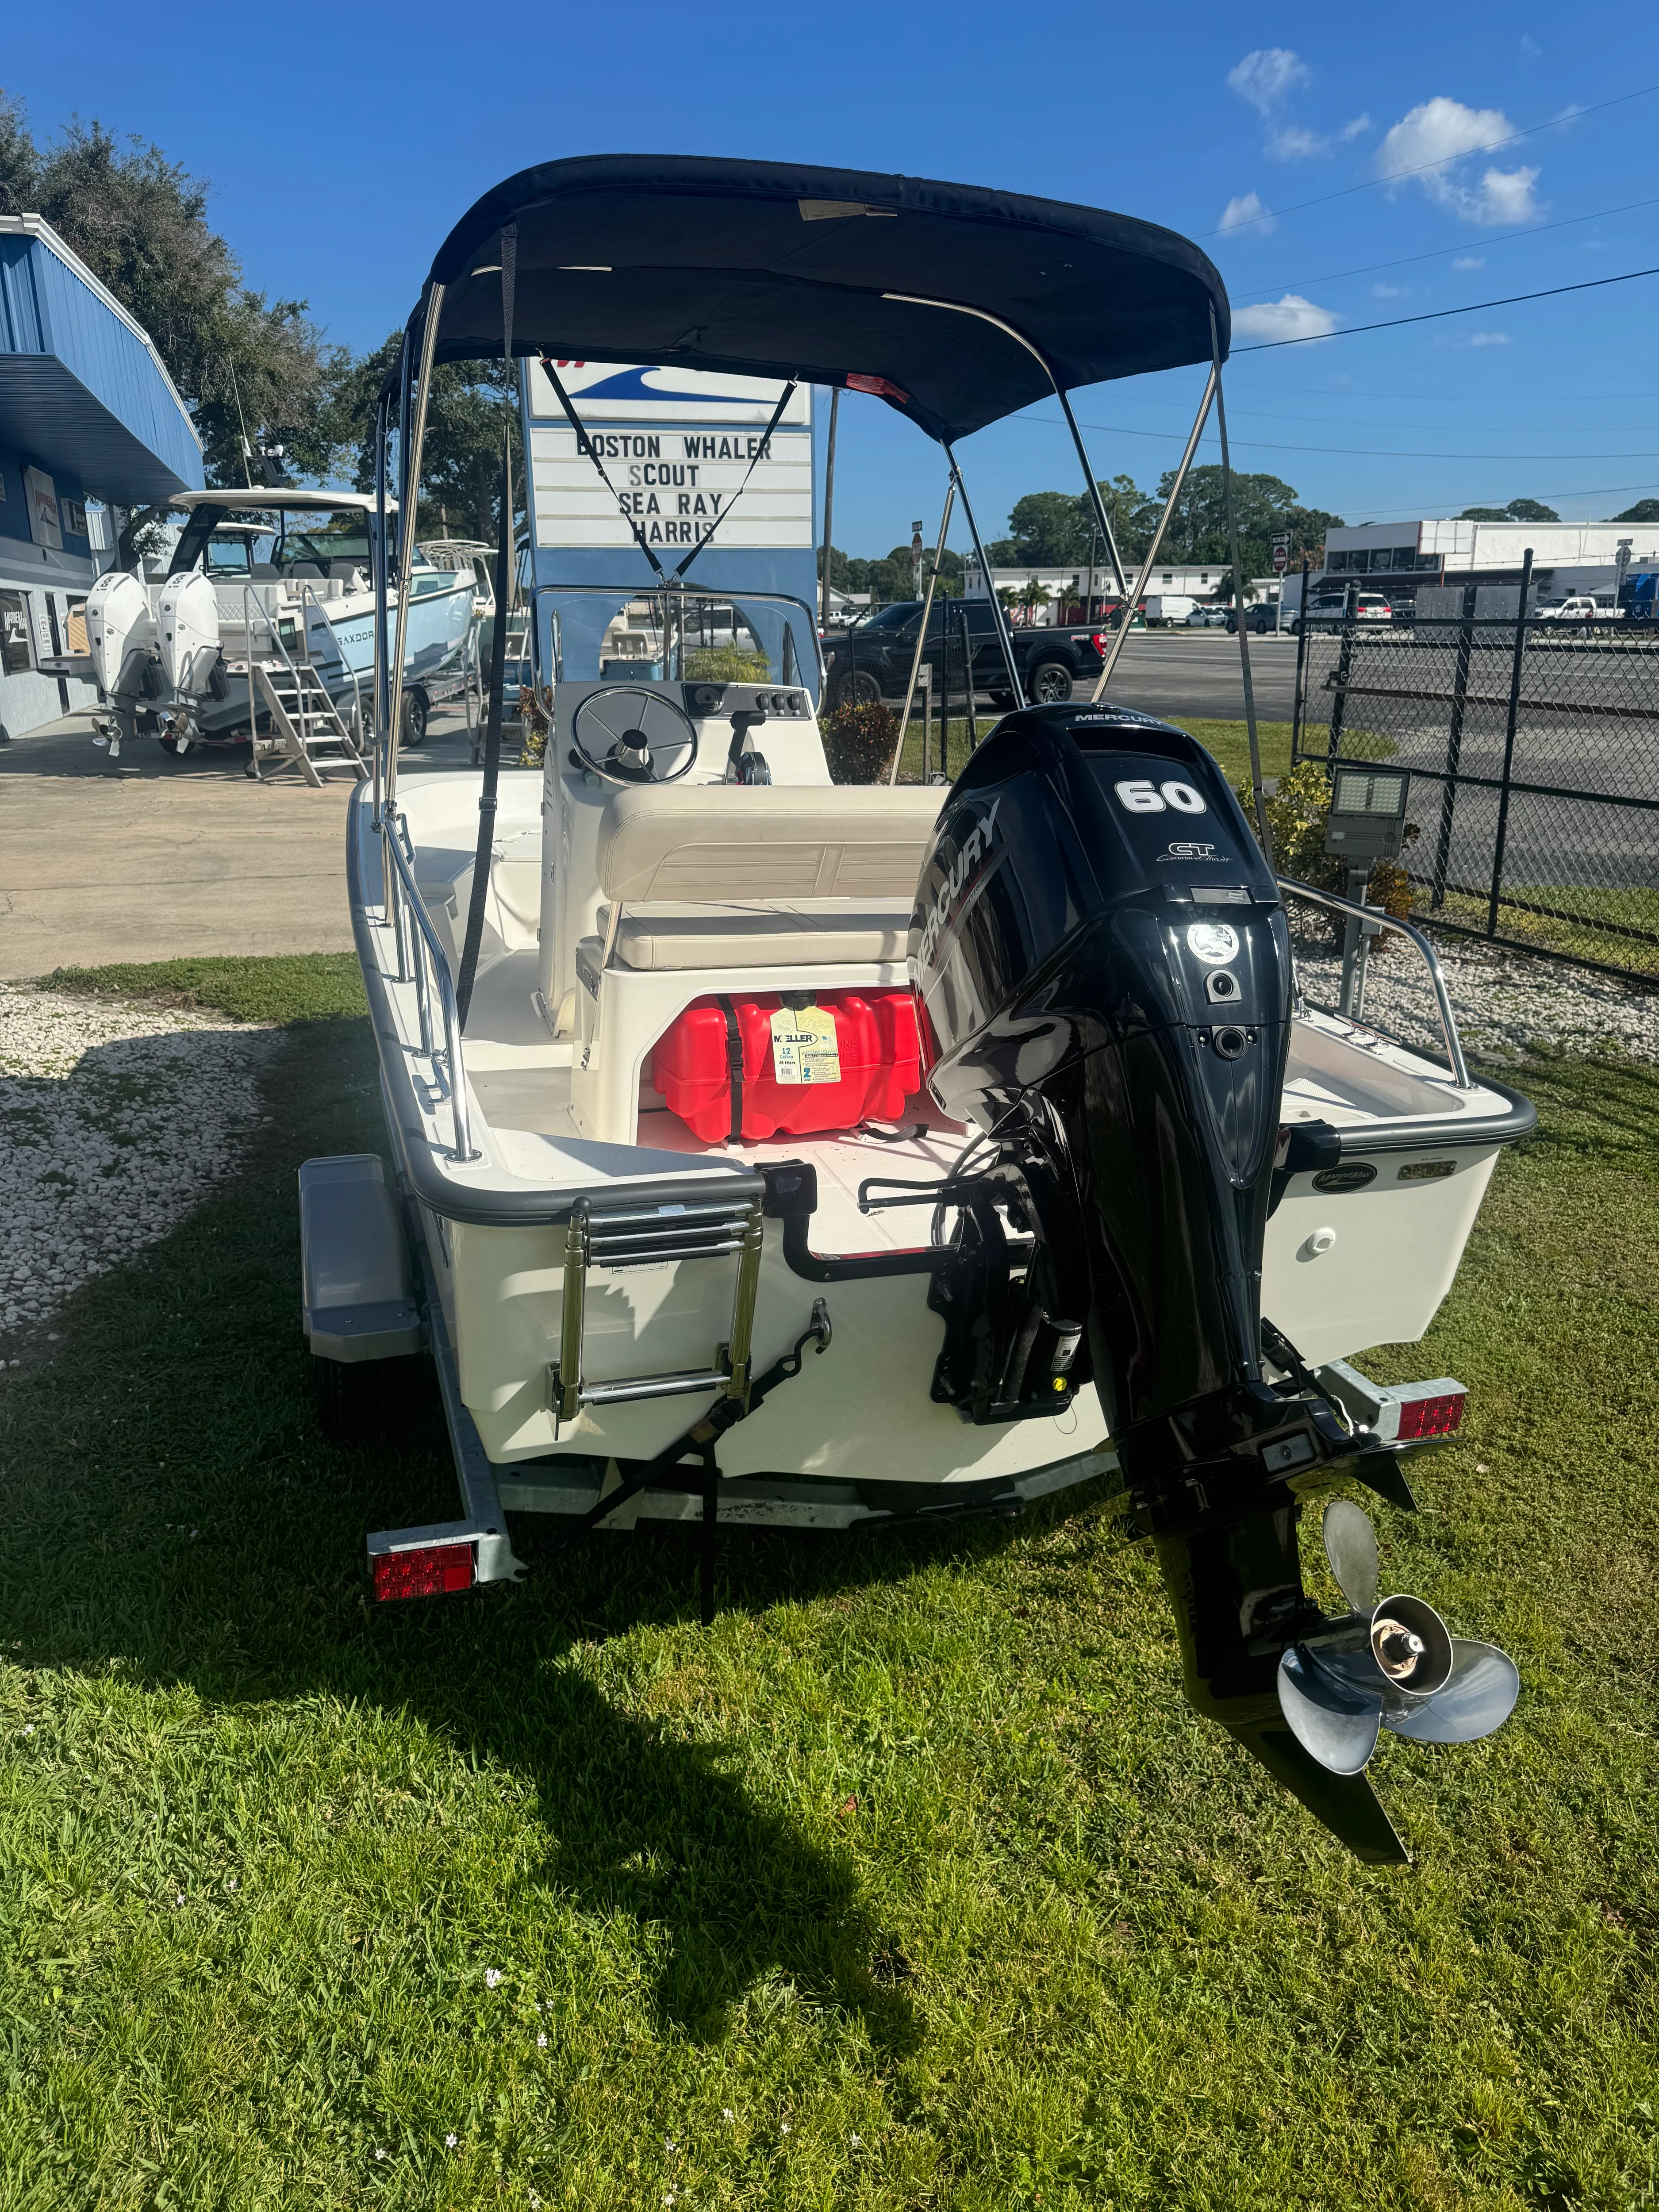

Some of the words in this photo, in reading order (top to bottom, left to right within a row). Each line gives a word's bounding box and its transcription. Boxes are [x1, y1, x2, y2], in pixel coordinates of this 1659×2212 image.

[576, 434, 660, 458] BOSTON
[684, 437, 771, 460] WHALER
[630, 464, 699, 487] SCOUT
[619, 492, 661, 515] SEA
[678, 493, 722, 515] RAY
[633, 521, 714, 543] HARRIS
[337, 630, 374, 646] SAXDOR
[1075, 714, 1163, 725] MERCURY
[1114, 780, 1207, 814] 60
[914, 797, 1001, 1003] MERCURY
[803, 1067, 811, 1078] 2
